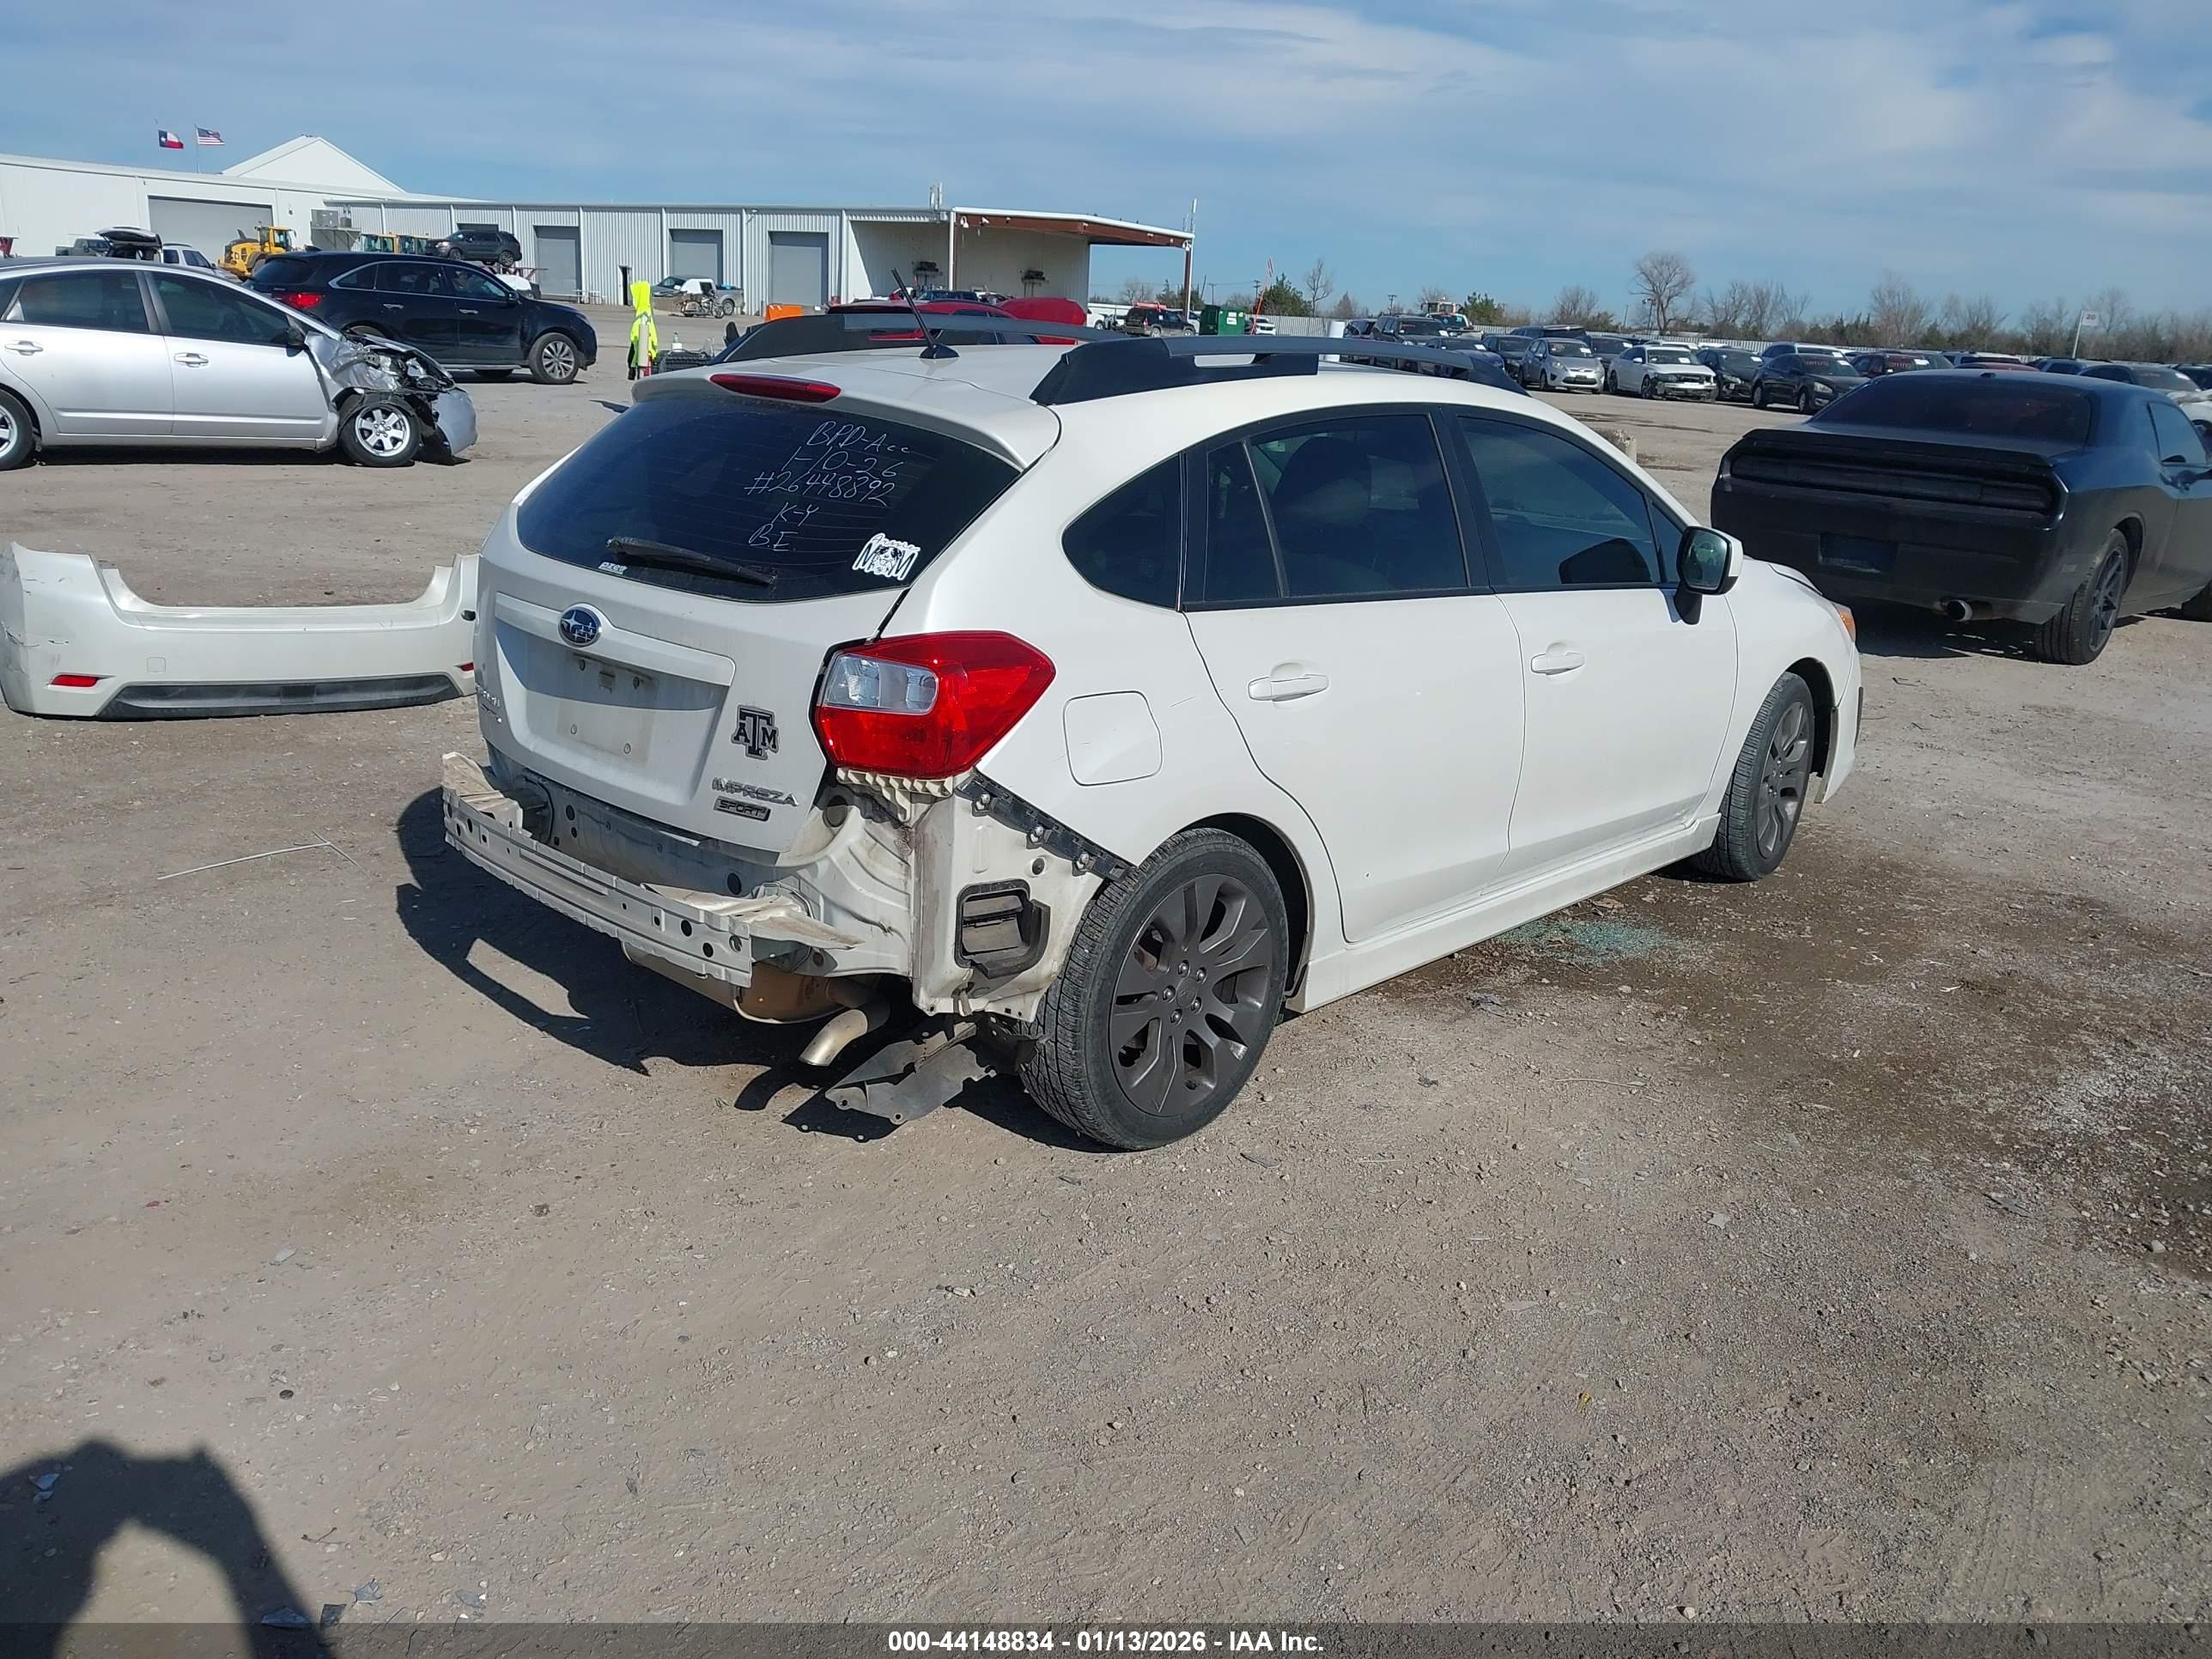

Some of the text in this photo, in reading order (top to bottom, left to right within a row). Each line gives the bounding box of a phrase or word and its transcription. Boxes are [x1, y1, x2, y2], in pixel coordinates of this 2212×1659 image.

[781, 446, 904, 480] 1-10-26
[744, 471, 896, 507] #26448892
[711, 776, 799, 807] IMPREZA
[719, 799, 768, 817] SPORT
